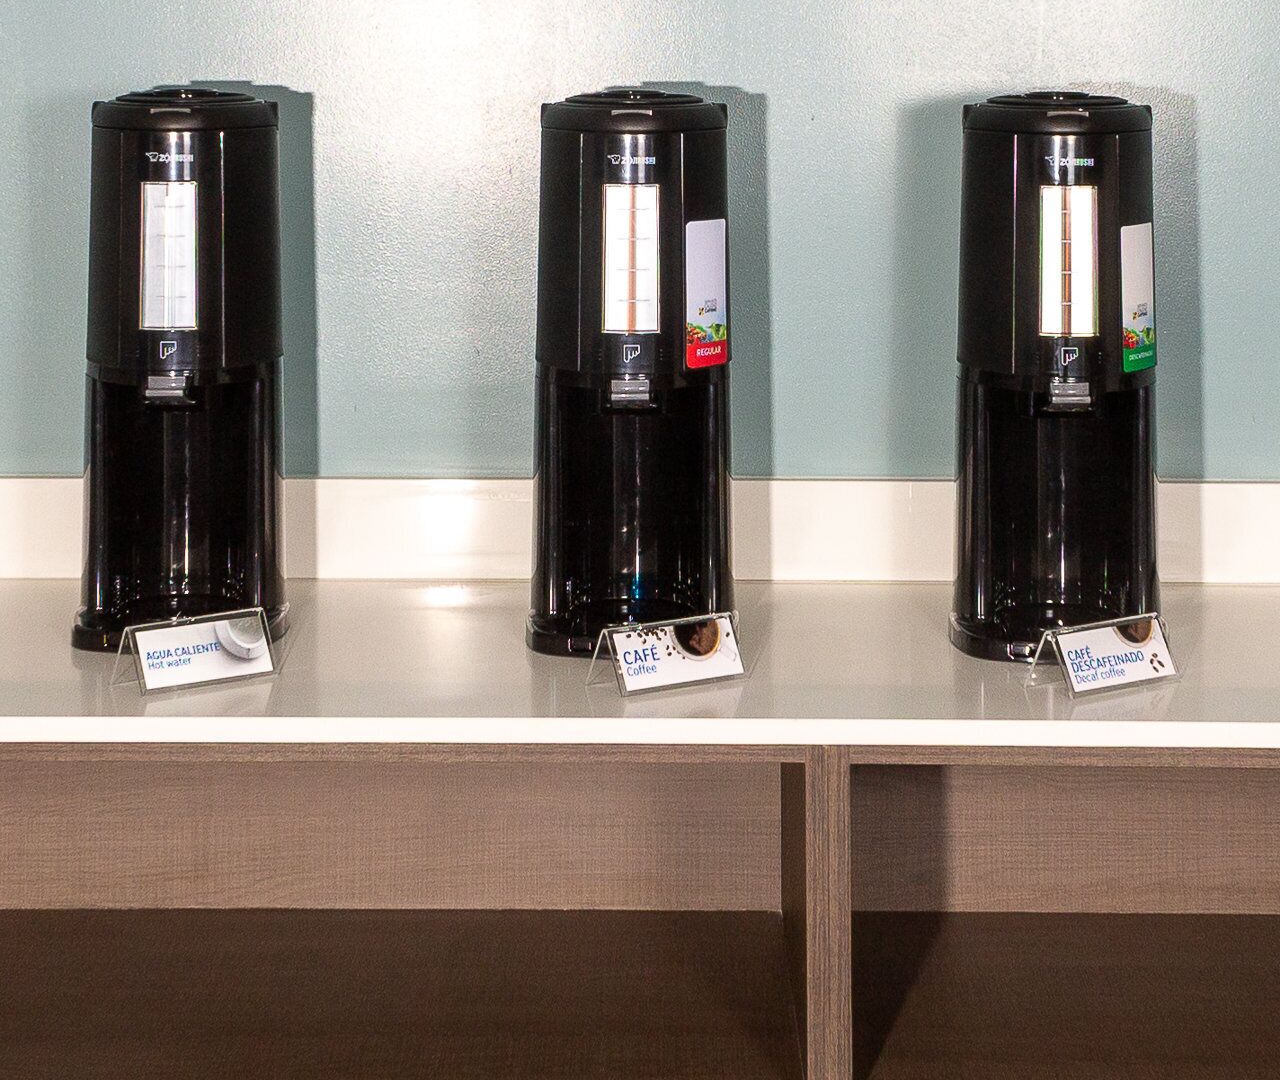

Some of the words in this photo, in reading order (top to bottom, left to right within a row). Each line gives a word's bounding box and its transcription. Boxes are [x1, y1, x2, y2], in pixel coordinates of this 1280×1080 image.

[696, 345, 722, 357] REGULAR
[146, 649, 173, 661] AGUA
[174, 641, 221, 657] CALIENTE
[623, 644, 660, 666] CAFÉ
[1067, 645, 1093, 663] CAFÉ
[148, 661, 165, 670] Hot
[167, 657, 192, 668] water
[626, 663, 657, 677] Coffee
[1071, 650, 1145, 674] DESCAFEINADO
[1074, 670, 1100, 685] Decaf
[1101, 667, 1126, 680] coffee
